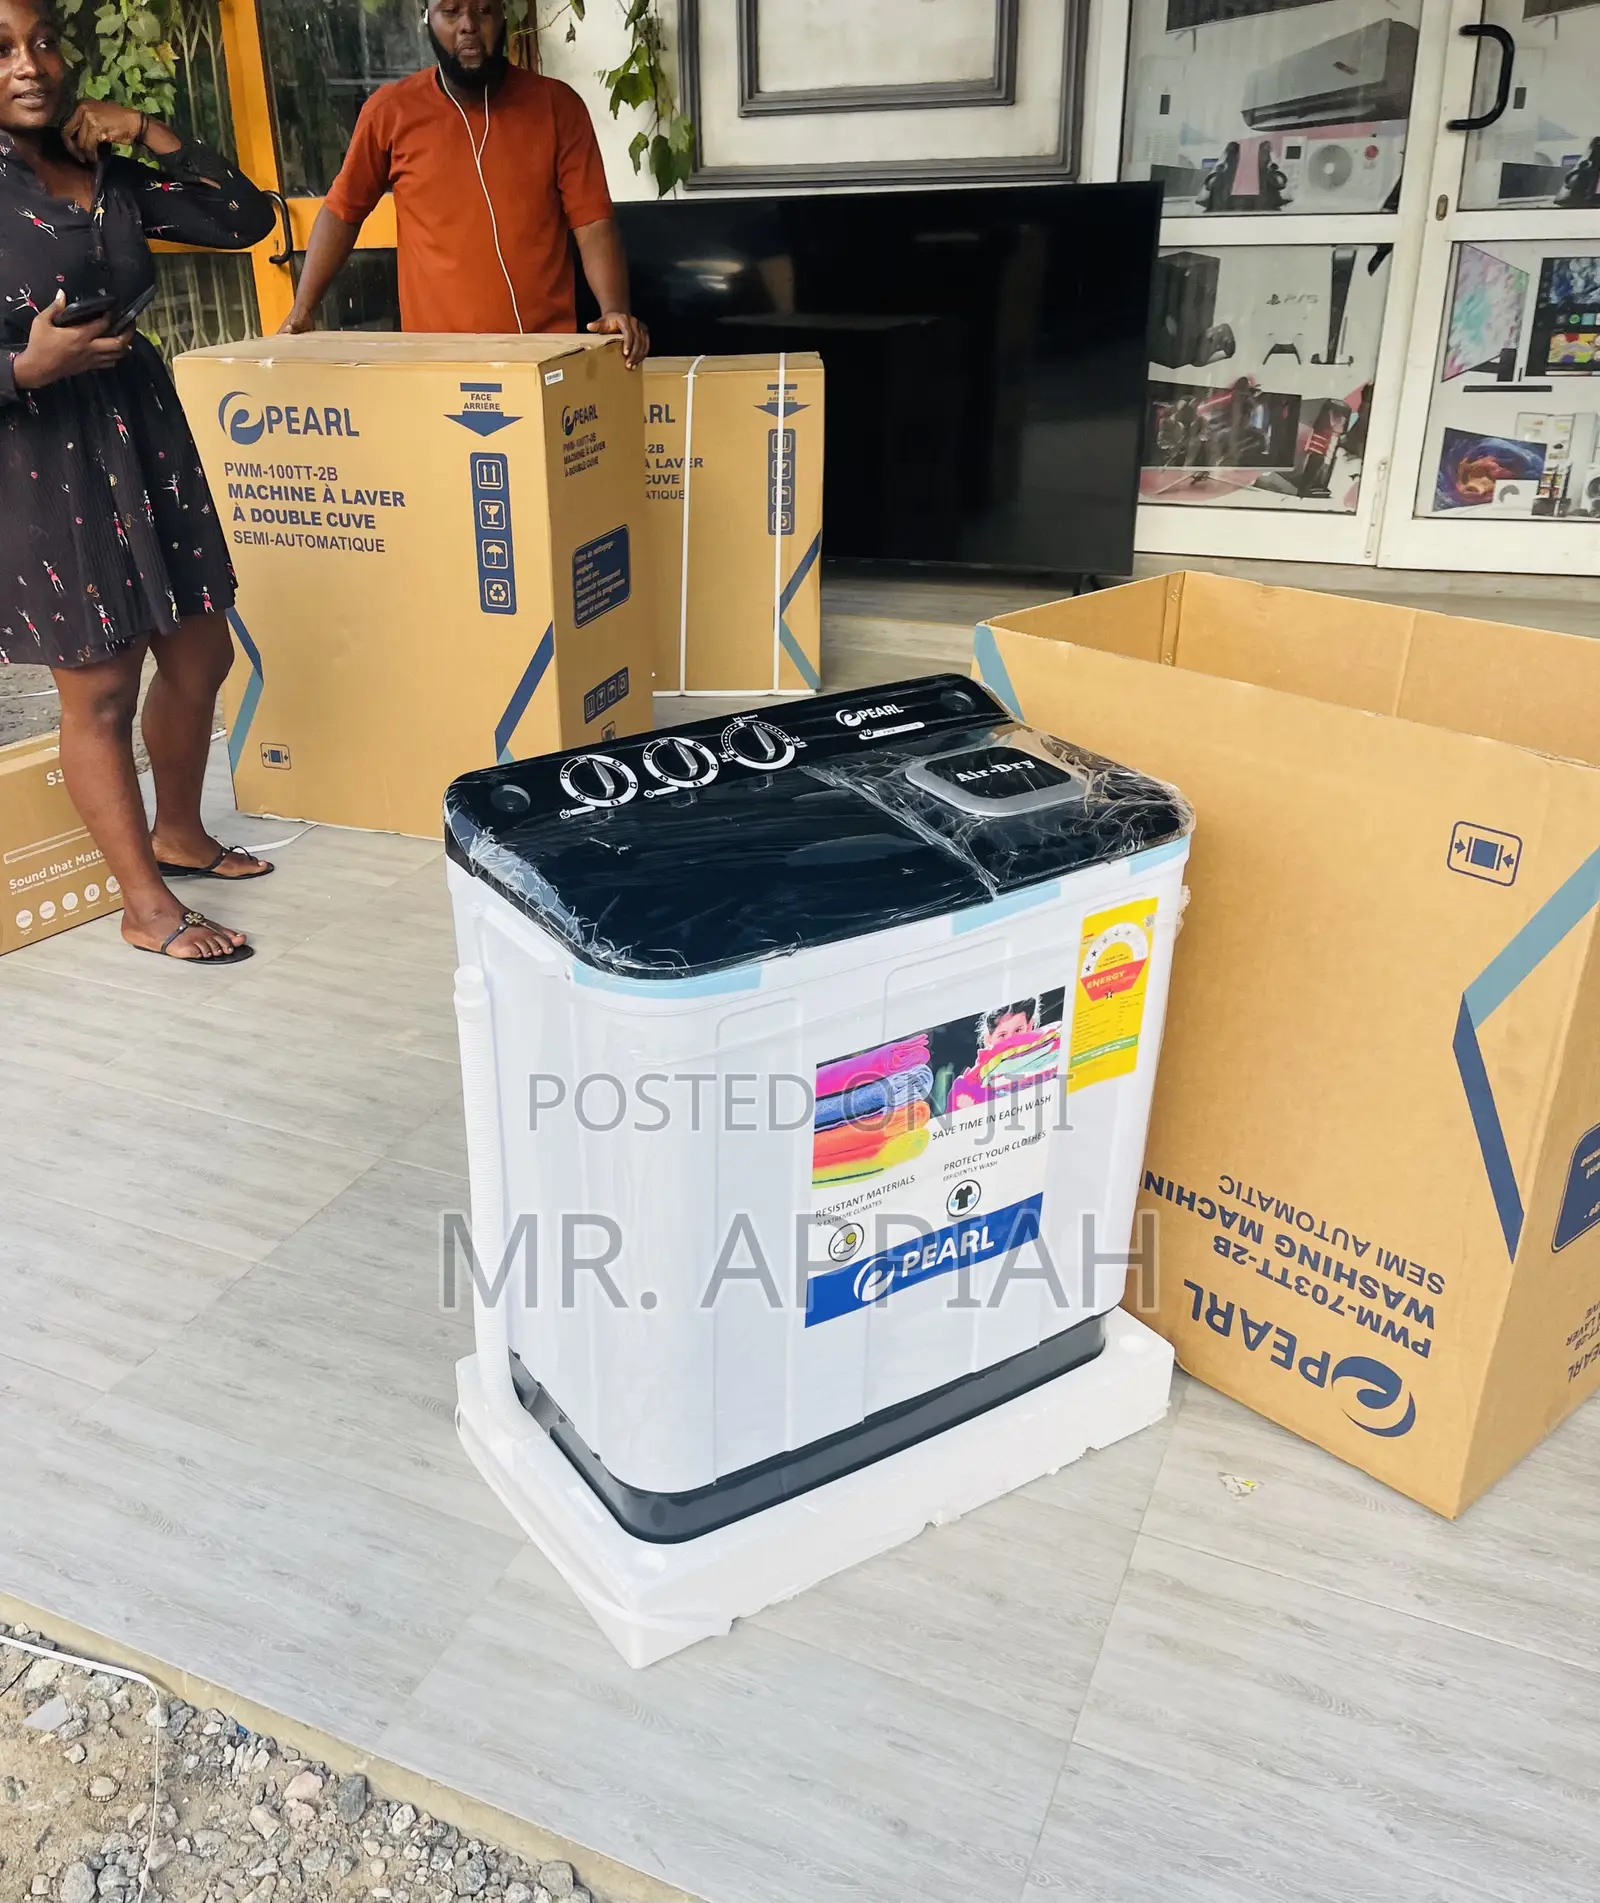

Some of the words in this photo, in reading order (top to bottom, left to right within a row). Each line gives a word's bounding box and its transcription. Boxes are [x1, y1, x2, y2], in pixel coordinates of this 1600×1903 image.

[1284, 294, 1319, 304] PS5
[470, 393, 492, 401] FACE
[265, 405, 360, 437] PEARL
[574, 403, 599, 428] PEARL
[644, 403, 676, 424] RL
[224, 462, 338, 482] PWM-100TT-2B
[227, 483, 317, 503] MACHINE
[322, 483, 336, 504] À
[341, 488, 406, 508] LAVER
[232, 502, 246, 522] À
[250, 508, 322, 526] DOUBLE
[326, 512, 376, 530] CUVE
[233, 530, 386, 553] SEMI-AUTOMATIQUE
[856, 703, 904, 721] PEARL
[955, 759, 1037, 783] Air-Dry
[9, 867, 48, 890] Sound
[49, 859, 73, 876] that
[1086, 970, 1126, 989] ENERGY
[932, 1125, 957, 1141] SAVE
[960, 1117, 983, 1131] TIME
[986, 1114, 996, 1124] IN
[999, 1106, 1023, 1121] EACH
[1025, 1094, 1052, 1112] WASH
[943, 1152, 984, 1172] PROTECT
[985, 1143, 1010, 1160] YOUR
[1012, 1131, 1047, 1151] CLOTHES
[979, 1160, 998, 1170] WASH
[815, 1194, 865, 1219] RESISTANT
[866, 1174, 916, 1201] MATERIALS
[1138, 1170, 1264, 1245] MACHIN
[1218, 1174, 1371, 1259] AUTOMATIC
[901, 1225, 995, 1278] PEARL
[1274, 1233, 1436, 1330] WASHING
[1376, 1246, 1446, 1296] SEMI
[1212, 1235, 1433, 1359] PWM-703TT-2B
[1184, 1279, 1332, 1389] PEARL
[1568, 1341, 1600, 1384] EARL
